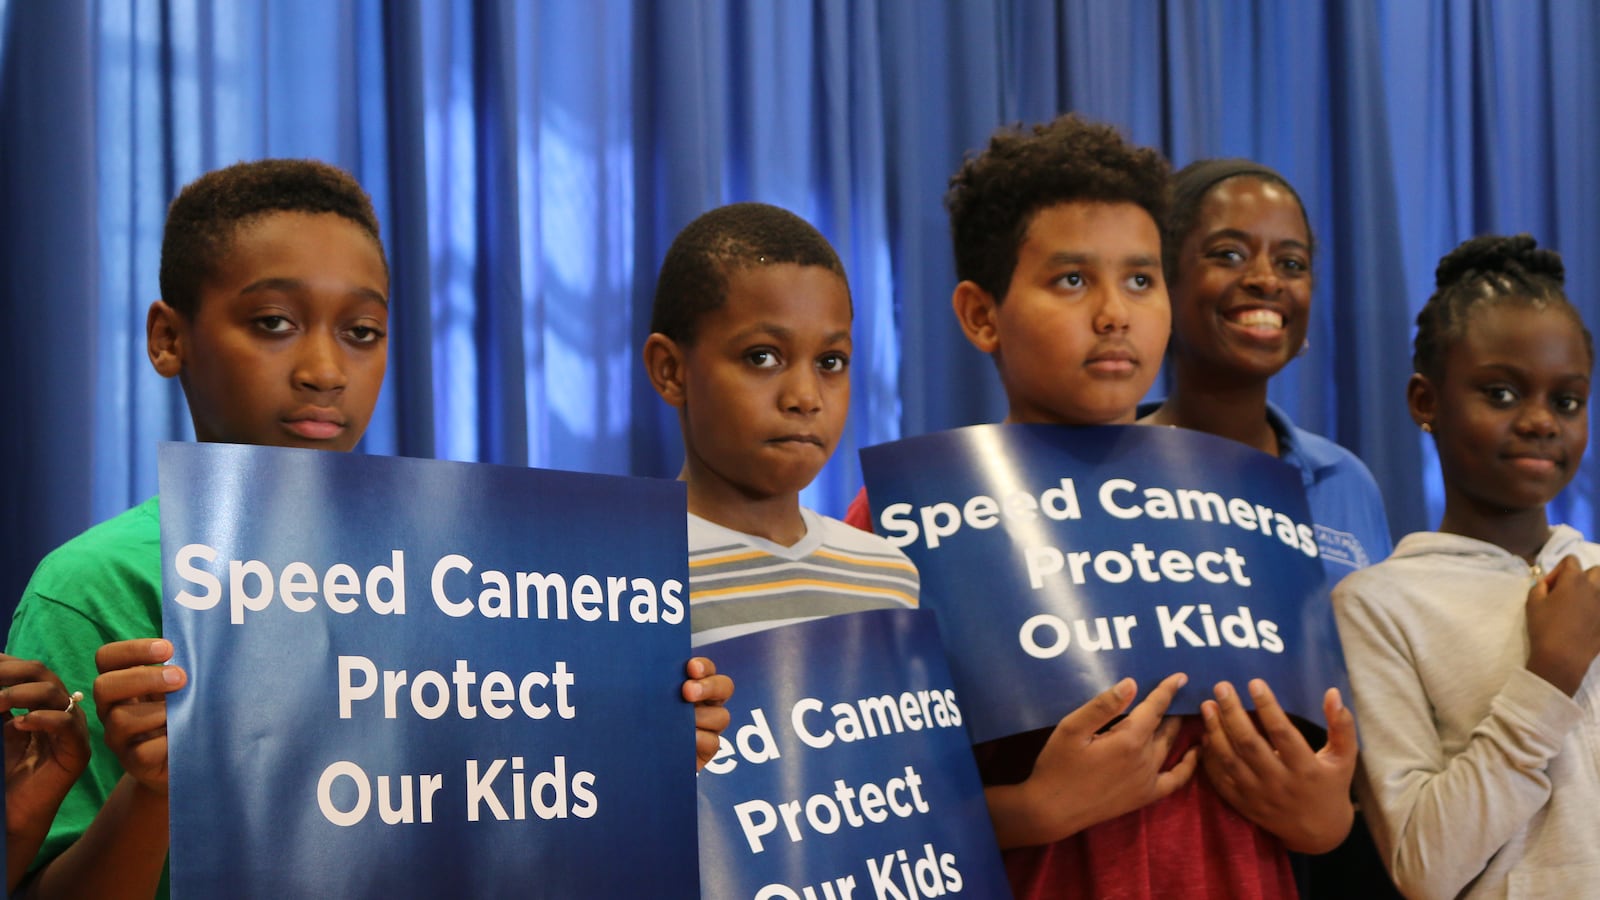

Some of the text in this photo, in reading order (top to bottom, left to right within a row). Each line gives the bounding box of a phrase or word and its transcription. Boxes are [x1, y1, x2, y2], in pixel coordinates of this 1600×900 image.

[880, 478, 1318, 558] Speed Cameras
[174, 543, 685, 625] Speed Cameras
[1024, 543, 1251, 589] Protect
[1019, 603, 1285, 659] Our Kids
[338, 655, 576, 720] Protect
[791, 688, 963, 749] Cameras
[316, 756, 598, 827] Our Kids
[734, 765, 930, 854] Protect
[866, 843, 963, 900] Kids
